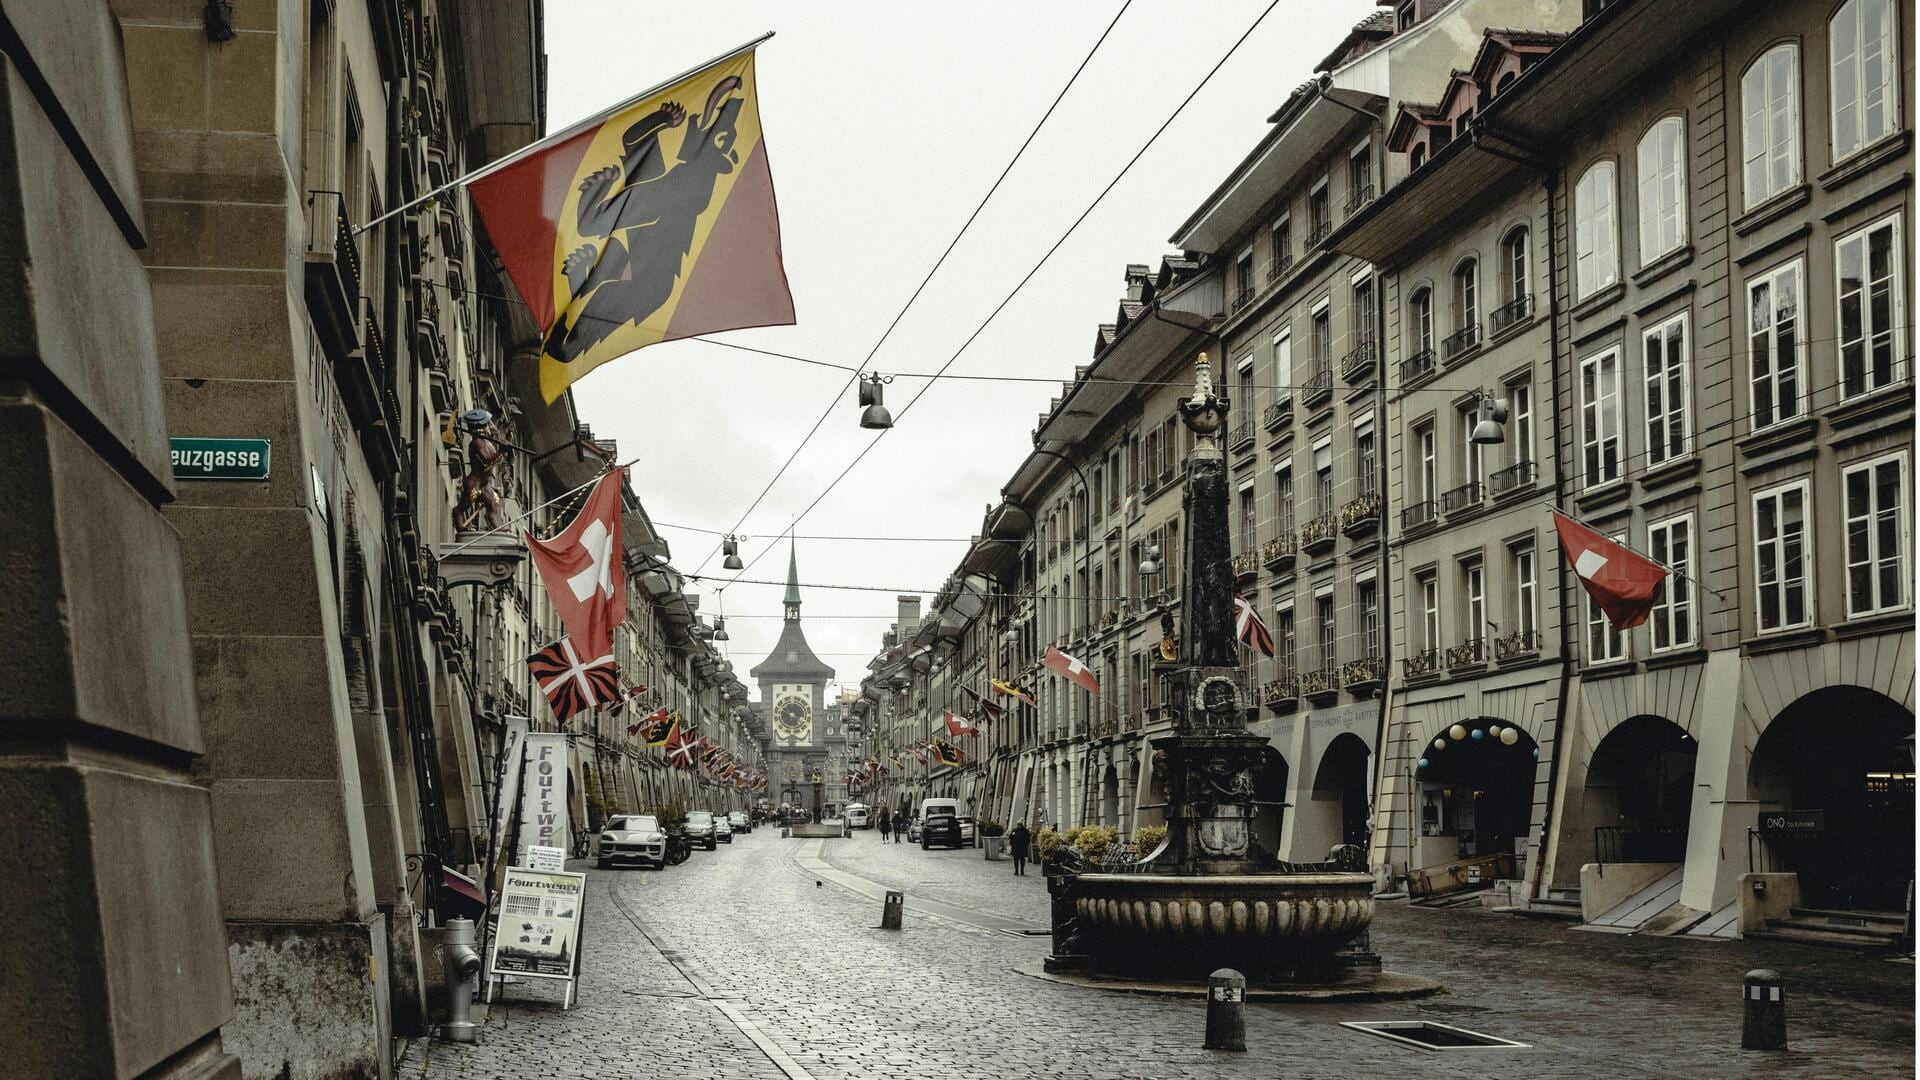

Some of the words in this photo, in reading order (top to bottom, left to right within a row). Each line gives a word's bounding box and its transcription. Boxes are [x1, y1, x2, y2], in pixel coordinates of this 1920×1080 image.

[309, 324, 331, 427] POST
[171, 450, 260, 472] euzgasse
[1767, 817, 1785, 828] ONO
